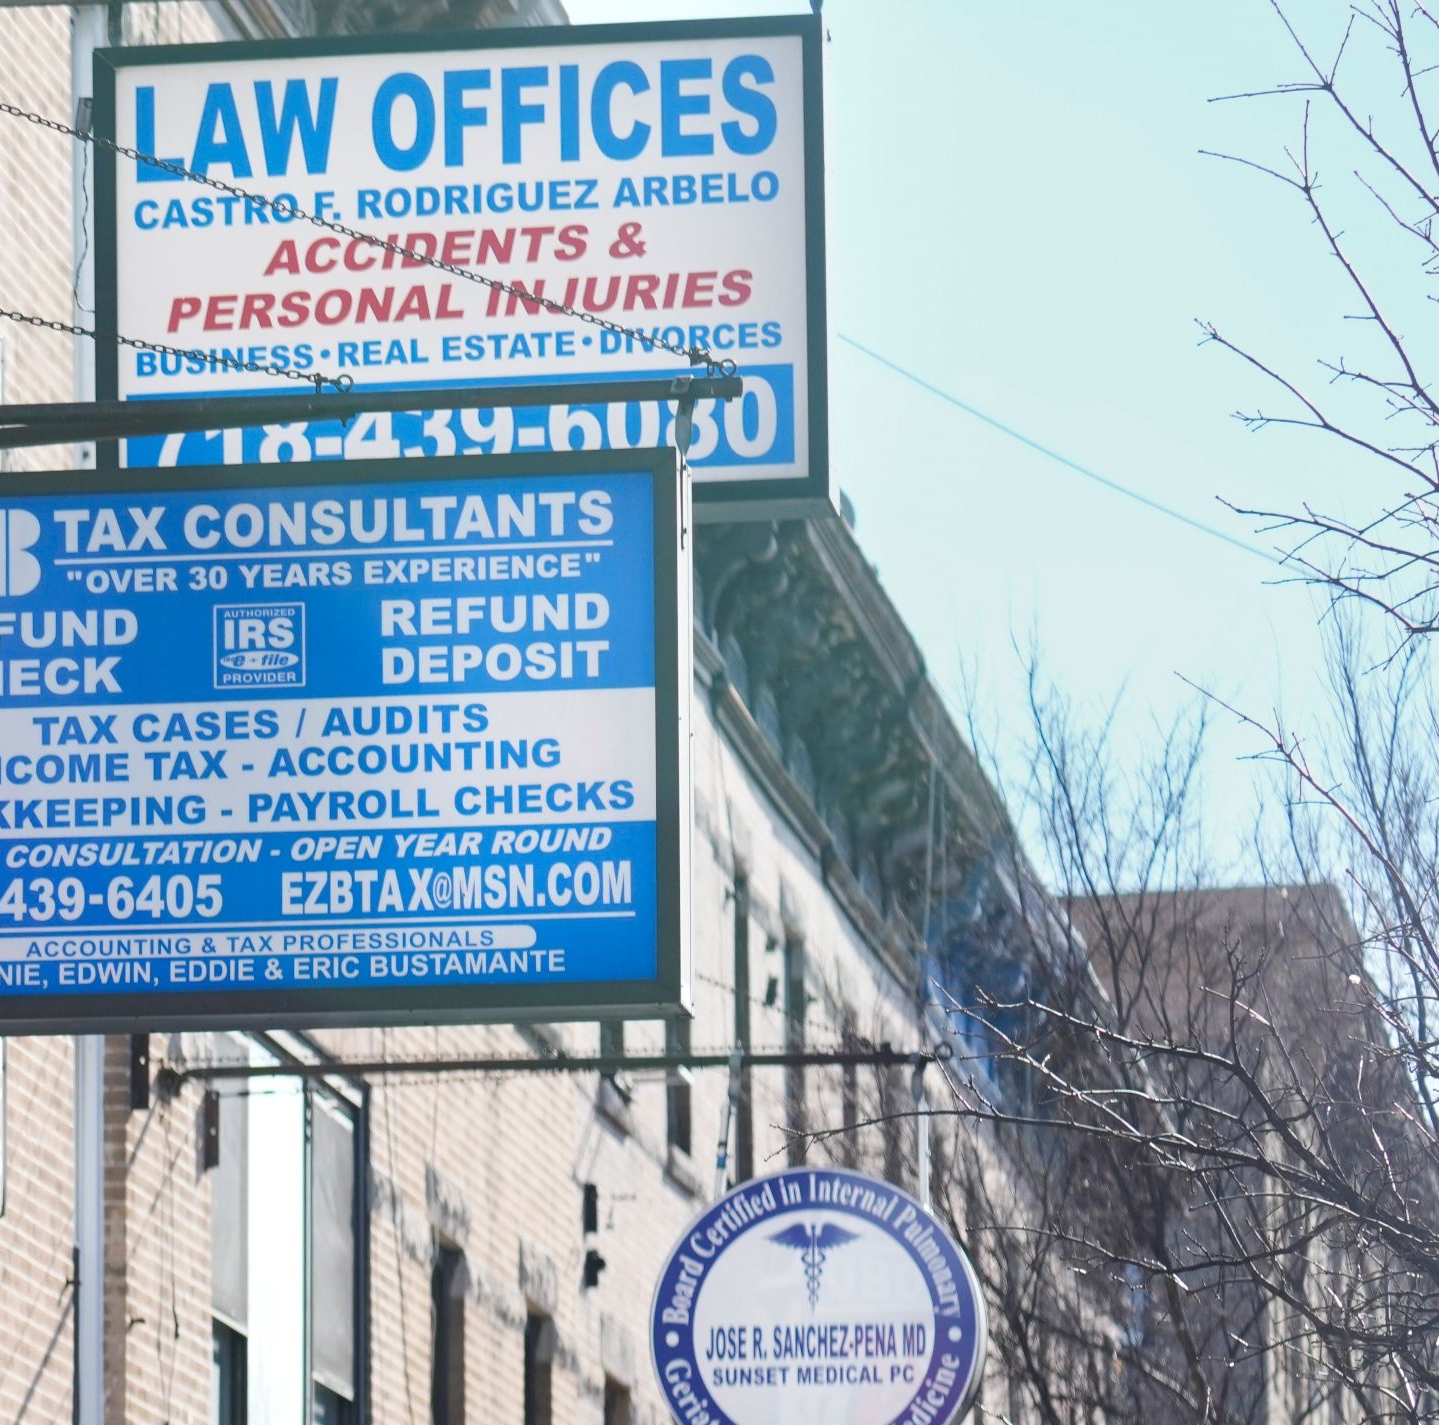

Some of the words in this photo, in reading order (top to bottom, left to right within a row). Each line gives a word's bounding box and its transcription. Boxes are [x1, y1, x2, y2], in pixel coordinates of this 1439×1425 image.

[135, 76, 338, 184] LAW
[370, 53, 778, 174] OFFICES
[134, 193, 297, 230] CASTRO
[314, 191, 342, 222] F.
[357, 180, 600, 217] RODRIGUEZ
[612, 169, 780, 208] ARBELO
[263, 223, 589, 277] ACCIDENTS
[166, 281, 463, 333] PERSONAL
[484, 269, 752, 319] INJURIES
[136, 344, 315, 378] BUSINESS
[337, 340, 430, 367] REAL
[442, 330, 574, 363] ESTATE
[600, 321, 782, 354] DIVORCES
[53, 506, 168, 553] TAX
[183, 490, 613, 550] CONSULTANTS
[66, 568, 181, 595] "OVER
[189, 566, 228, 590] 30
[238, 562, 352, 589] YEARS
[364, 552, 601, 585] EXPERIENCE"
[224, 608, 295, 618] AUTHORIZED
[224, 618, 294, 650] IRS
[381, 594, 611, 637] REFUND
[223, 672, 296, 684] PROVIDER
[381, 640, 609, 684] DEPOSIT
[33, 715, 117, 746] TAX
[132, 708, 279, 743] CASES
[322, 703, 489, 736] AUDITS
[145, 750, 230, 782] TAX
[268, 738, 561, 777] ACCOUNTING
[248, 788, 440, 822] PAYROLL
[455, 780, 634, 816] CHECKS
[5, 839, 262, 867] CONSULTATION
[290, 835, 378, 861] OPEN
[393, 832, 484, 858] YEAR
[495, 827, 611, 854] ROUND
[281, 860, 632, 916] EZBTAX@MSN.COM
[25, 936, 191, 958] ACCOUNTING
[225, 934, 273, 954] TAX
[279, 929, 495, 950] PROFESSIONALS
[58, 959, 160, 986] EDWIN,
[169, 958, 256, 981] EDDIE
[292, 954, 361, 977] ERIC
[370, 950, 566, 975] BUSTAMANTE
[662, 1254, 705, 1326] Board
[691, 1181, 777, 1258] Certified
[780, 1179, 801, 1205] in
[809, 1174, 897, 1225] Internal
[894, 1204, 961, 1318] Pulmonary
[706, 1327, 746, 1361] JOSE
[754, 1327, 767, 1360] R.
[773, 1325, 896, 1360] SANCHEZ-PENA
[903, 1323, 925, 1357] MD
[713, 1366, 789, 1386] SUNSET
[797, 1365, 883, 1385] MEDICAL
[891, 1364, 915, 1384] PC
